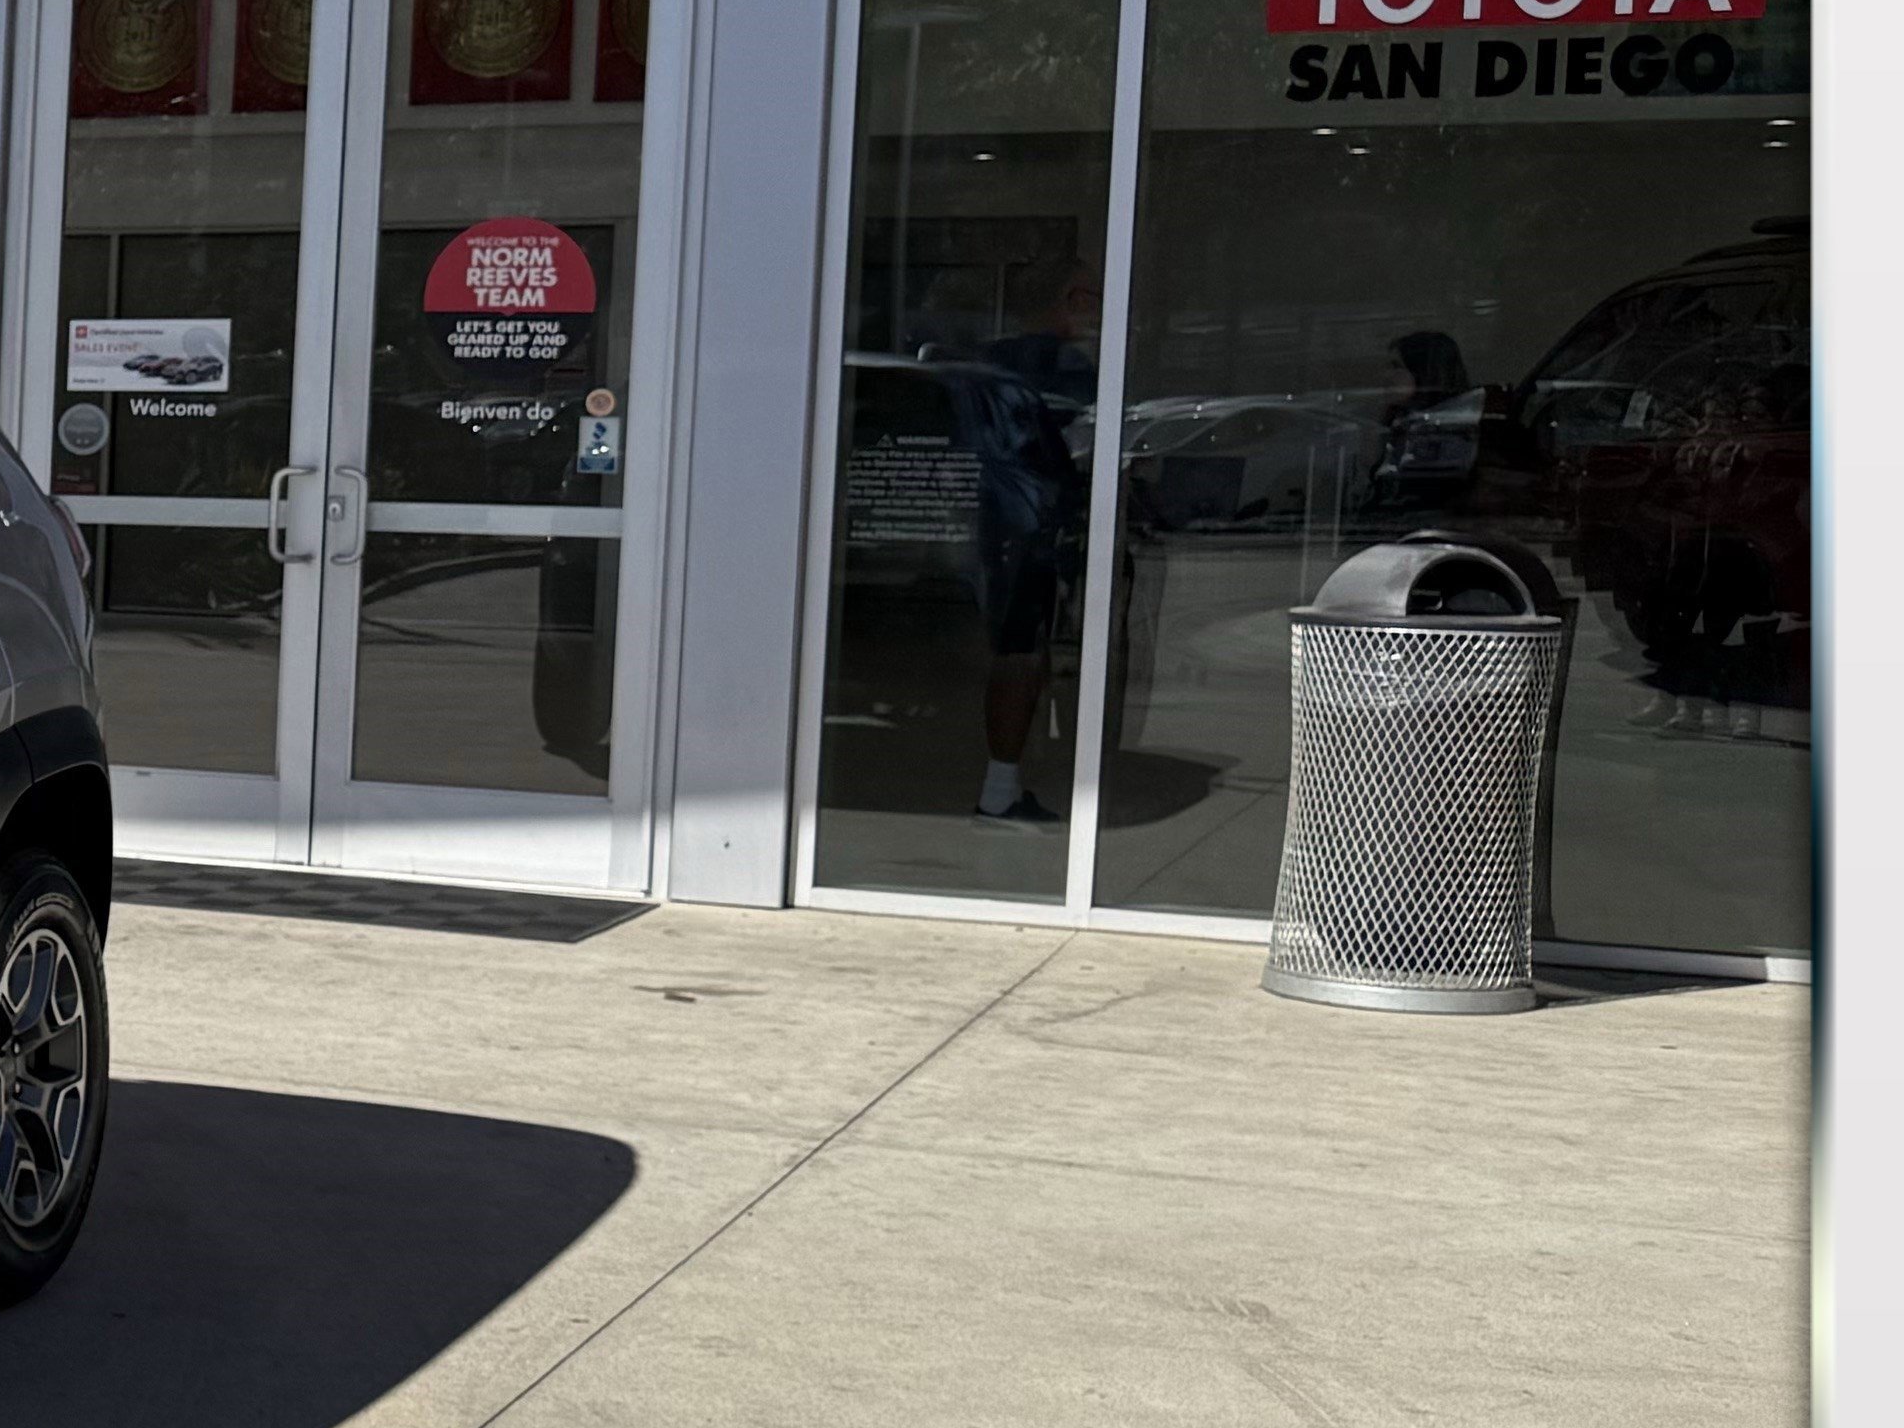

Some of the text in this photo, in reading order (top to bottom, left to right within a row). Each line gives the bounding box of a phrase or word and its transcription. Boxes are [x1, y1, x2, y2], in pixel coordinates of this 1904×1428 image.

[1285, 33, 1735, 103] SAN DIEGO
[471, 247, 553, 267] NORM
[466, 267, 558, 287] REEVES
[474, 287, 545, 307] TEAM
[456, 321, 560, 333] LET'S GET YOU
[447, 334, 568, 346] GEARED UP AND
[454, 346, 559, 358] READY TO GO!
[130, 398, 217, 417] Welcome
[441, 401, 555, 422] Bienvendo
